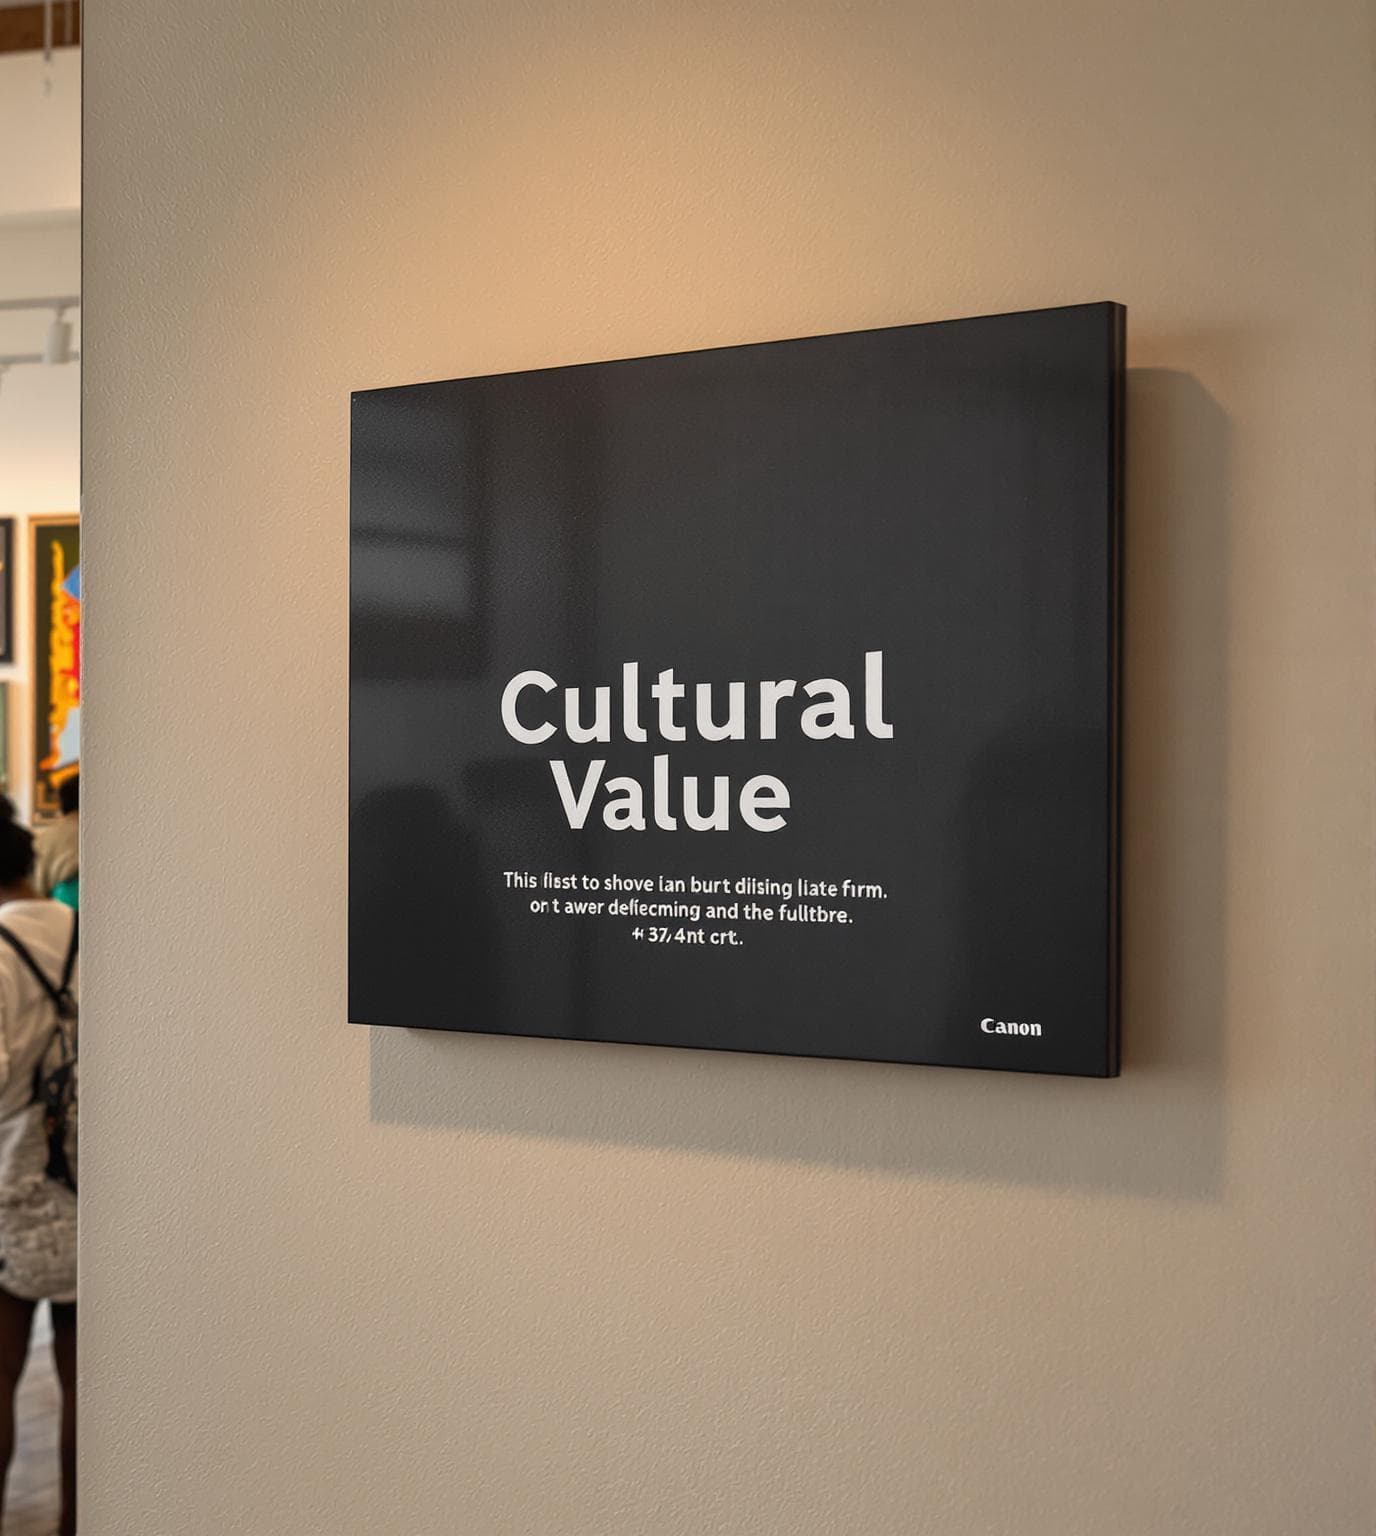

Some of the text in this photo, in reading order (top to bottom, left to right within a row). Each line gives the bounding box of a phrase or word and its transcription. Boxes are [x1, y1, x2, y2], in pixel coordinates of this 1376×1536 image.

[499, 650, 895, 746] Cultural
[549, 753, 792, 833] Value
[502, 870, 538, 890] This
[580, 873, 600, 891] to
[604, 873, 654, 893] shove
[840, 879, 888, 899] firm.
[564, 900, 605, 915] awer
[705, 902, 739, 920] and
[742, 902, 775, 921] the
[979, 1017, 1042, 1037] Canon
